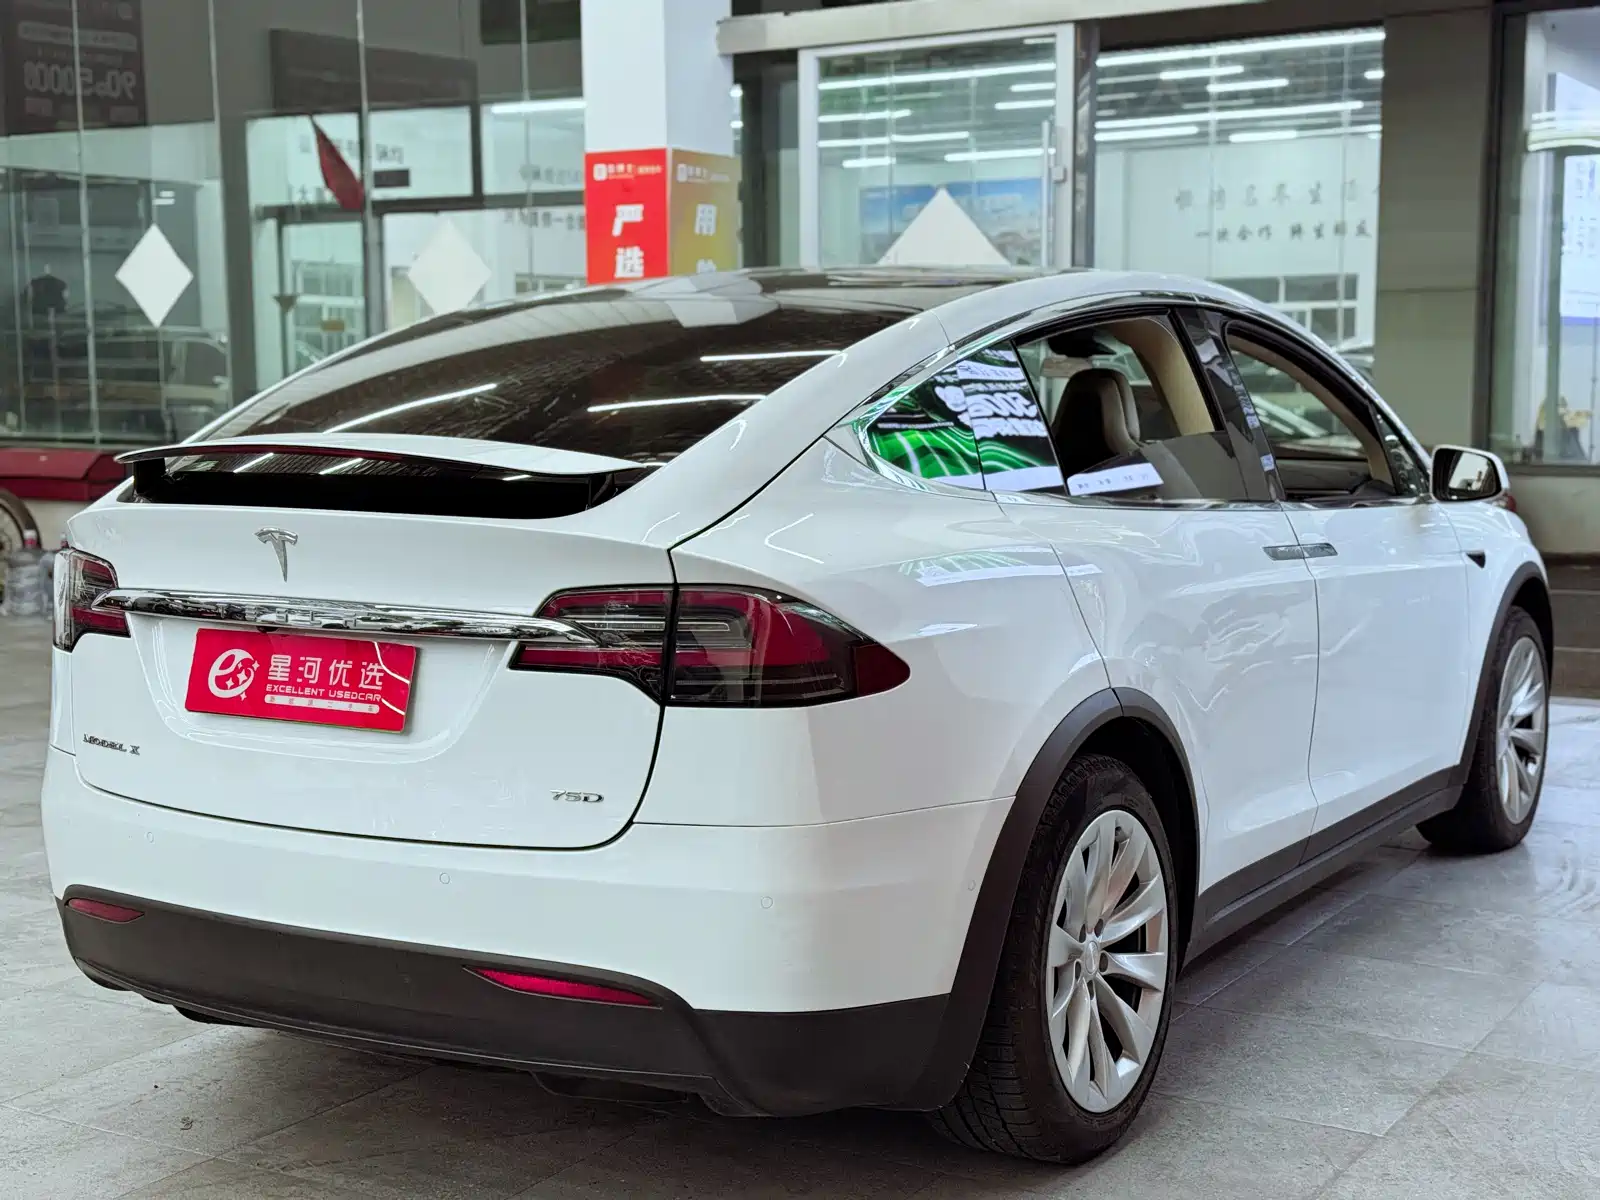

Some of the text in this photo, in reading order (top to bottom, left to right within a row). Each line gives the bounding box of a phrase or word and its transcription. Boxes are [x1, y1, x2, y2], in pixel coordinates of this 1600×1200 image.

[267, 654, 385, 691] 星河优选
[266, 684, 382, 703] EXCELLENT USEDCAR
[83, 733, 127, 753] MODEL
[549, 788, 605, 803] 75D
